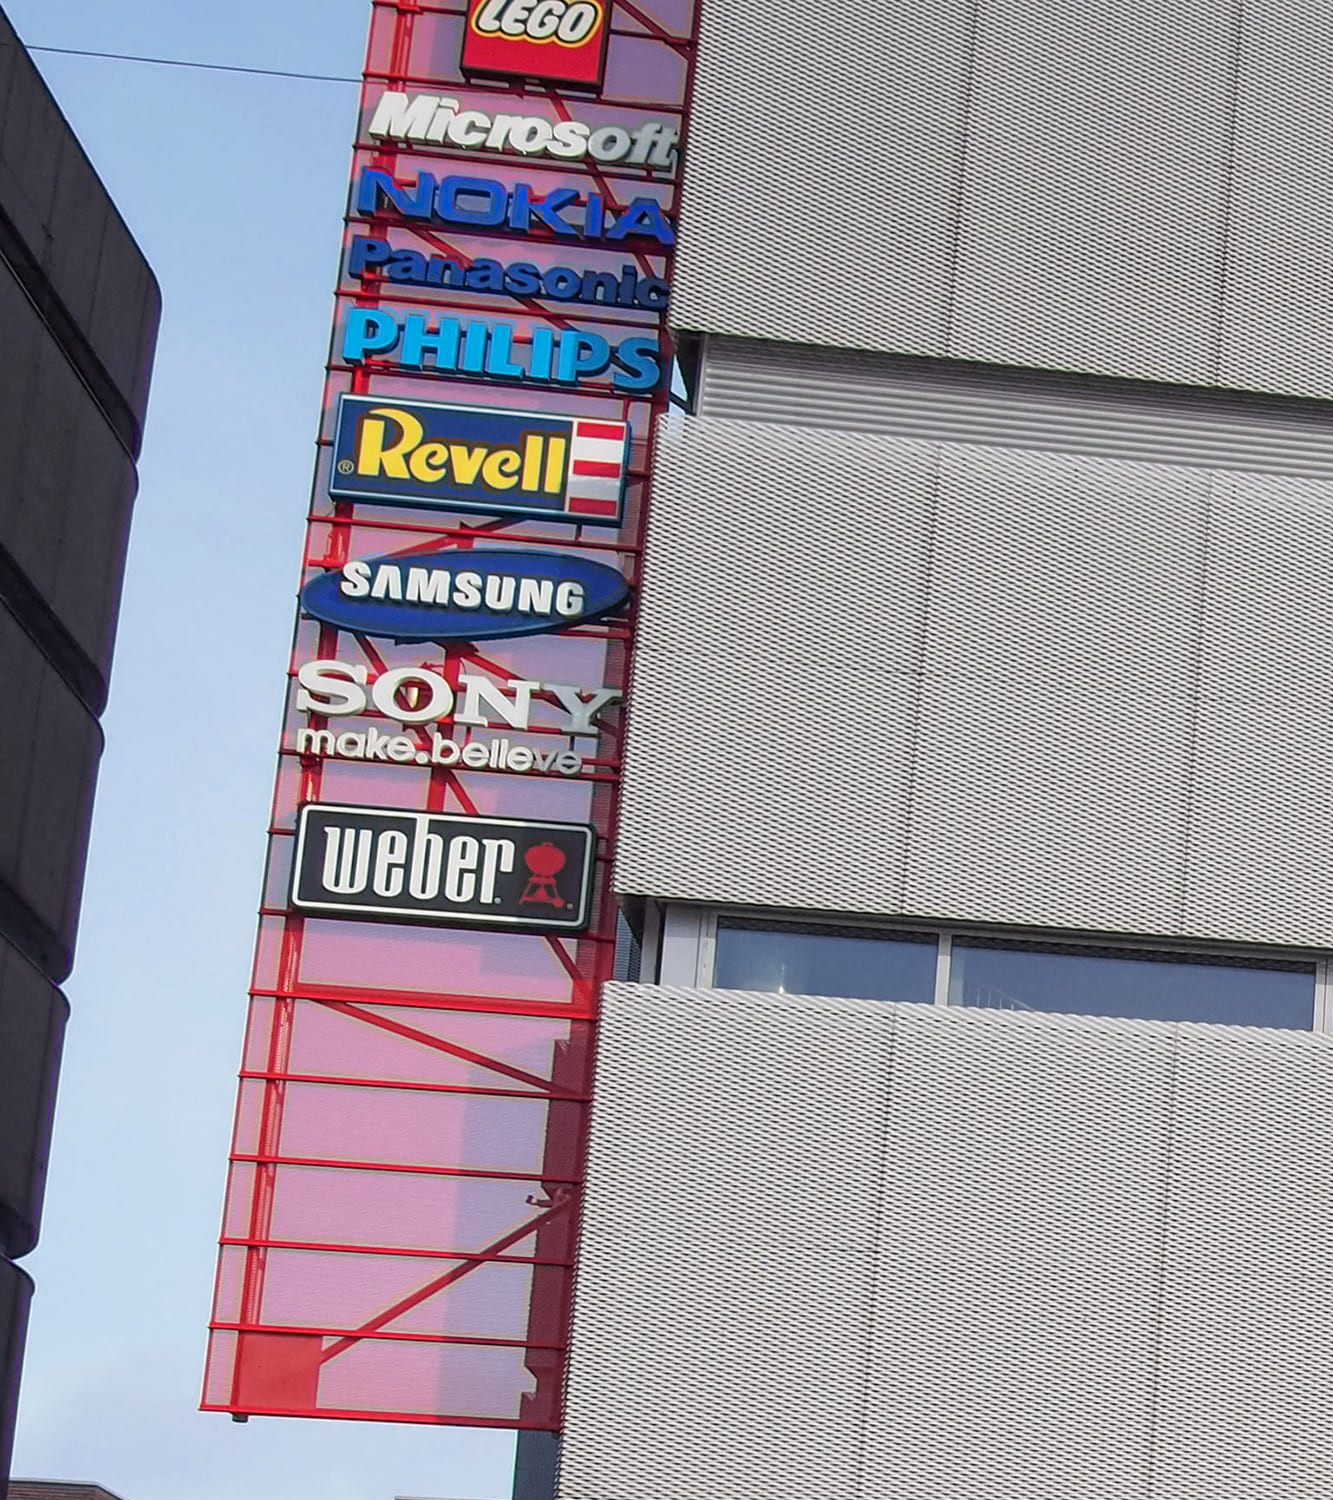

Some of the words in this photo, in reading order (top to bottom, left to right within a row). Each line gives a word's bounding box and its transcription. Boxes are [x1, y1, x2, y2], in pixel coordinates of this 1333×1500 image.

[478, 0, 597, 41] LEGO
[368, 92, 680, 167] Microsoft
[355, 166, 676, 246] NOKIA
[348, 235, 670, 309] Panasonic
[343, 308, 661, 394] PHILIPS
[358, 408, 567, 493] Revell
[340, 561, 586, 617] SAMSUNG
[295, 660, 623, 736] SONY
[322, 814, 516, 905] weber
